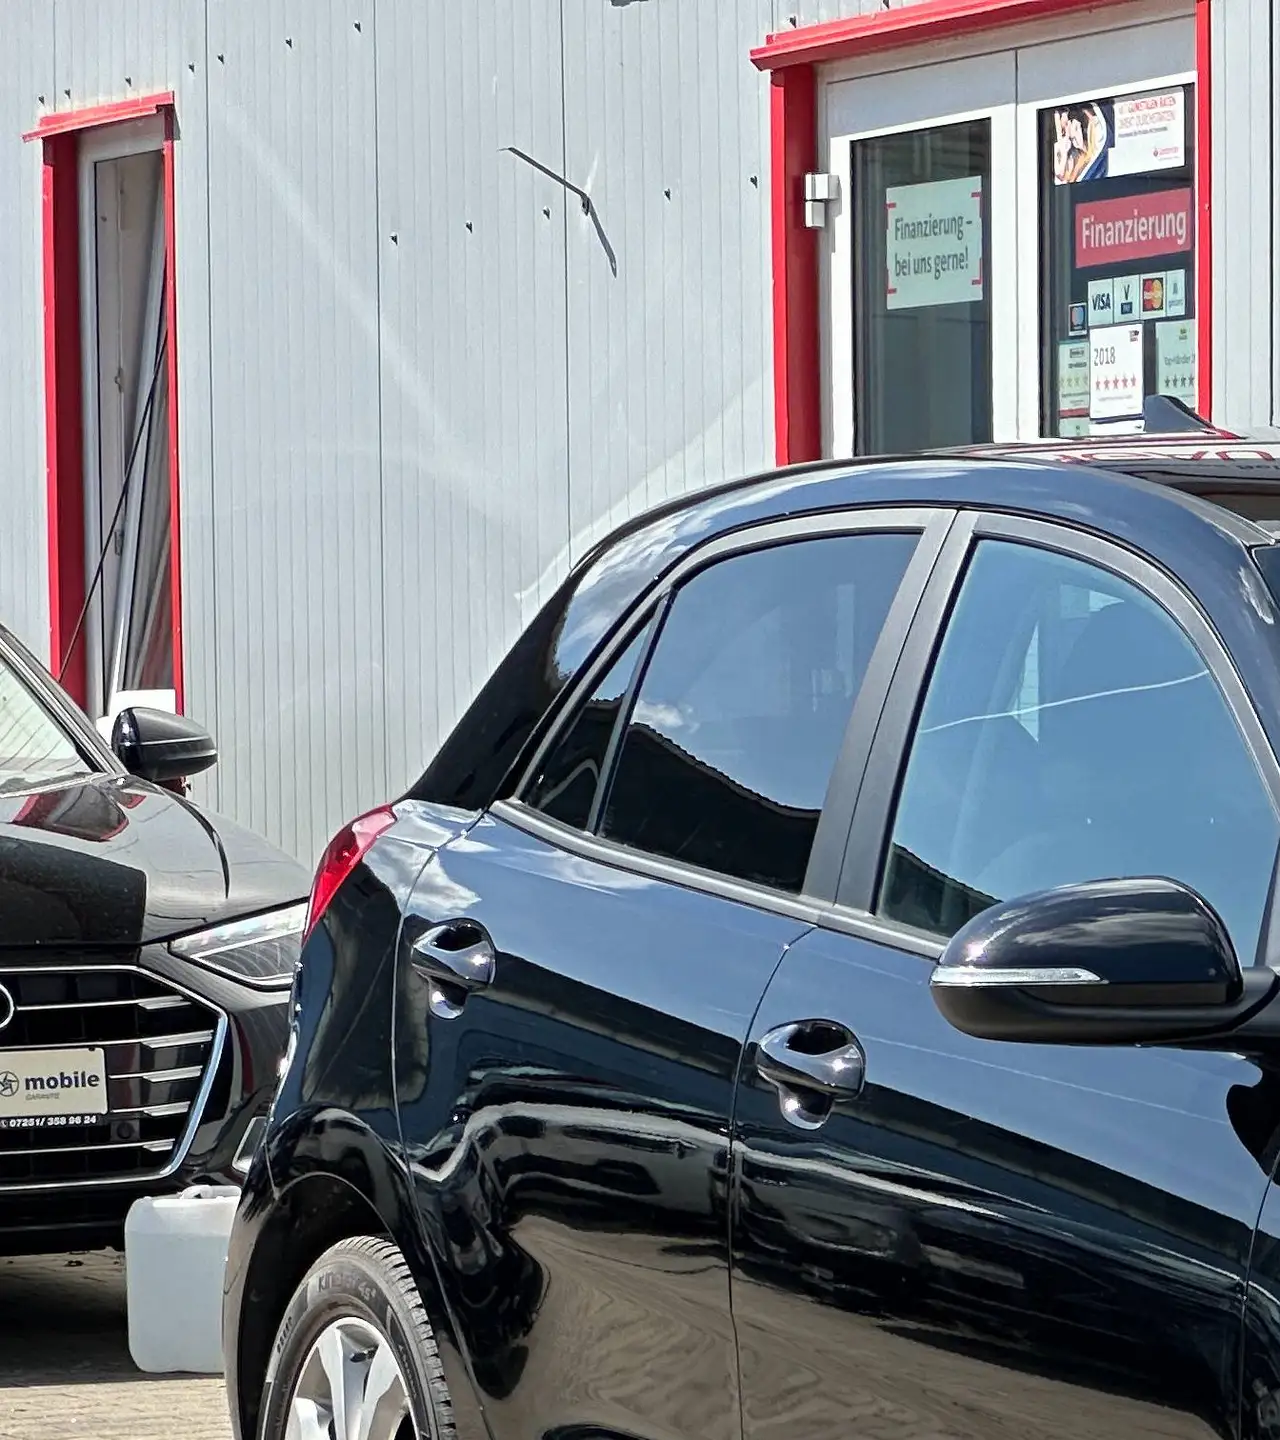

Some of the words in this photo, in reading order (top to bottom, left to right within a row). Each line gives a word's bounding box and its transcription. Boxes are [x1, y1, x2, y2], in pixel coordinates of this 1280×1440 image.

[894, 213, 964, 241] Finanzierung
[1082, 209, 1187, 249] Finanzierung
[894, 252, 911, 277] bei
[913, 256, 932, 275] uns
[934, 246, 969, 280] gerne!
[1091, 293, 1112, 311] VISA
[1093, 346, 1116, 366] 2018
[25, 1071, 100, 1090] mobile
[83, 1115, 97, 1124] 24
